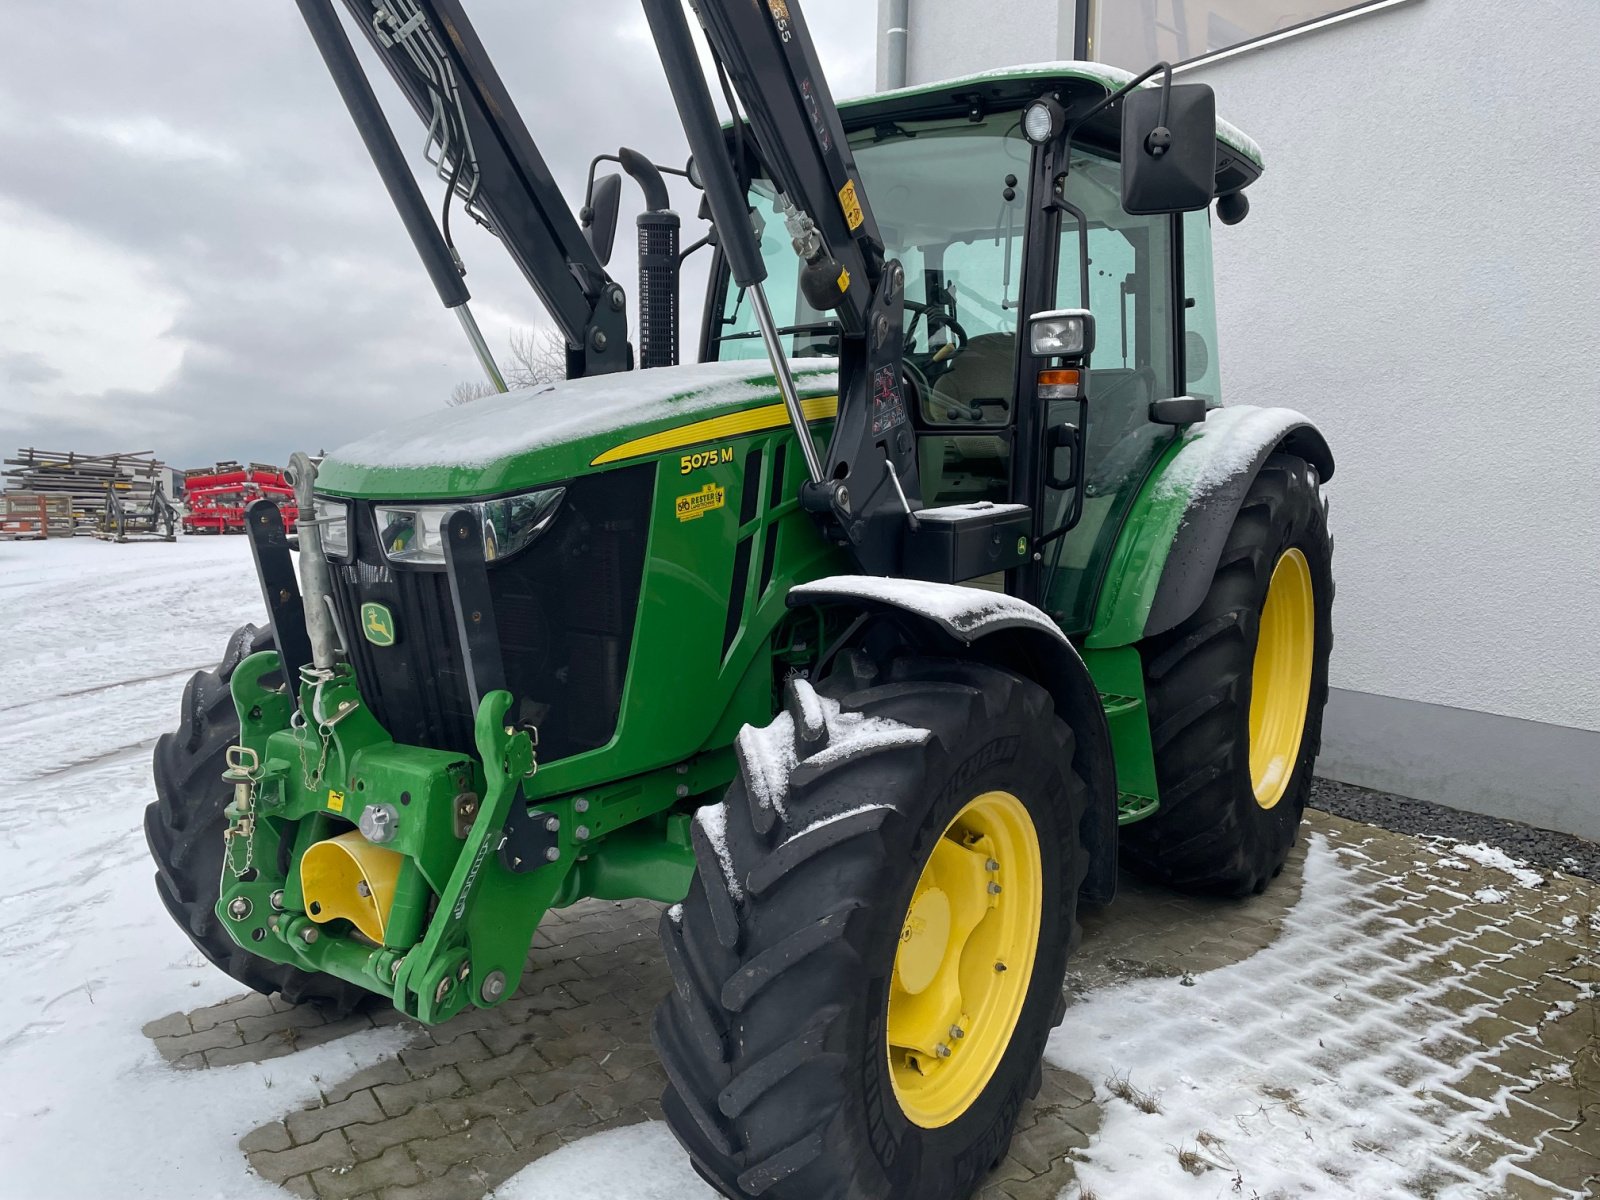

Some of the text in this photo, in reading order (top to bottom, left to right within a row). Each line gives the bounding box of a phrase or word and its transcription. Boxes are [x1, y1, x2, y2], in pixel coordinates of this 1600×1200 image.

[680, 446, 733, 475] 5075 M
[690, 492, 715, 505] RESTER
